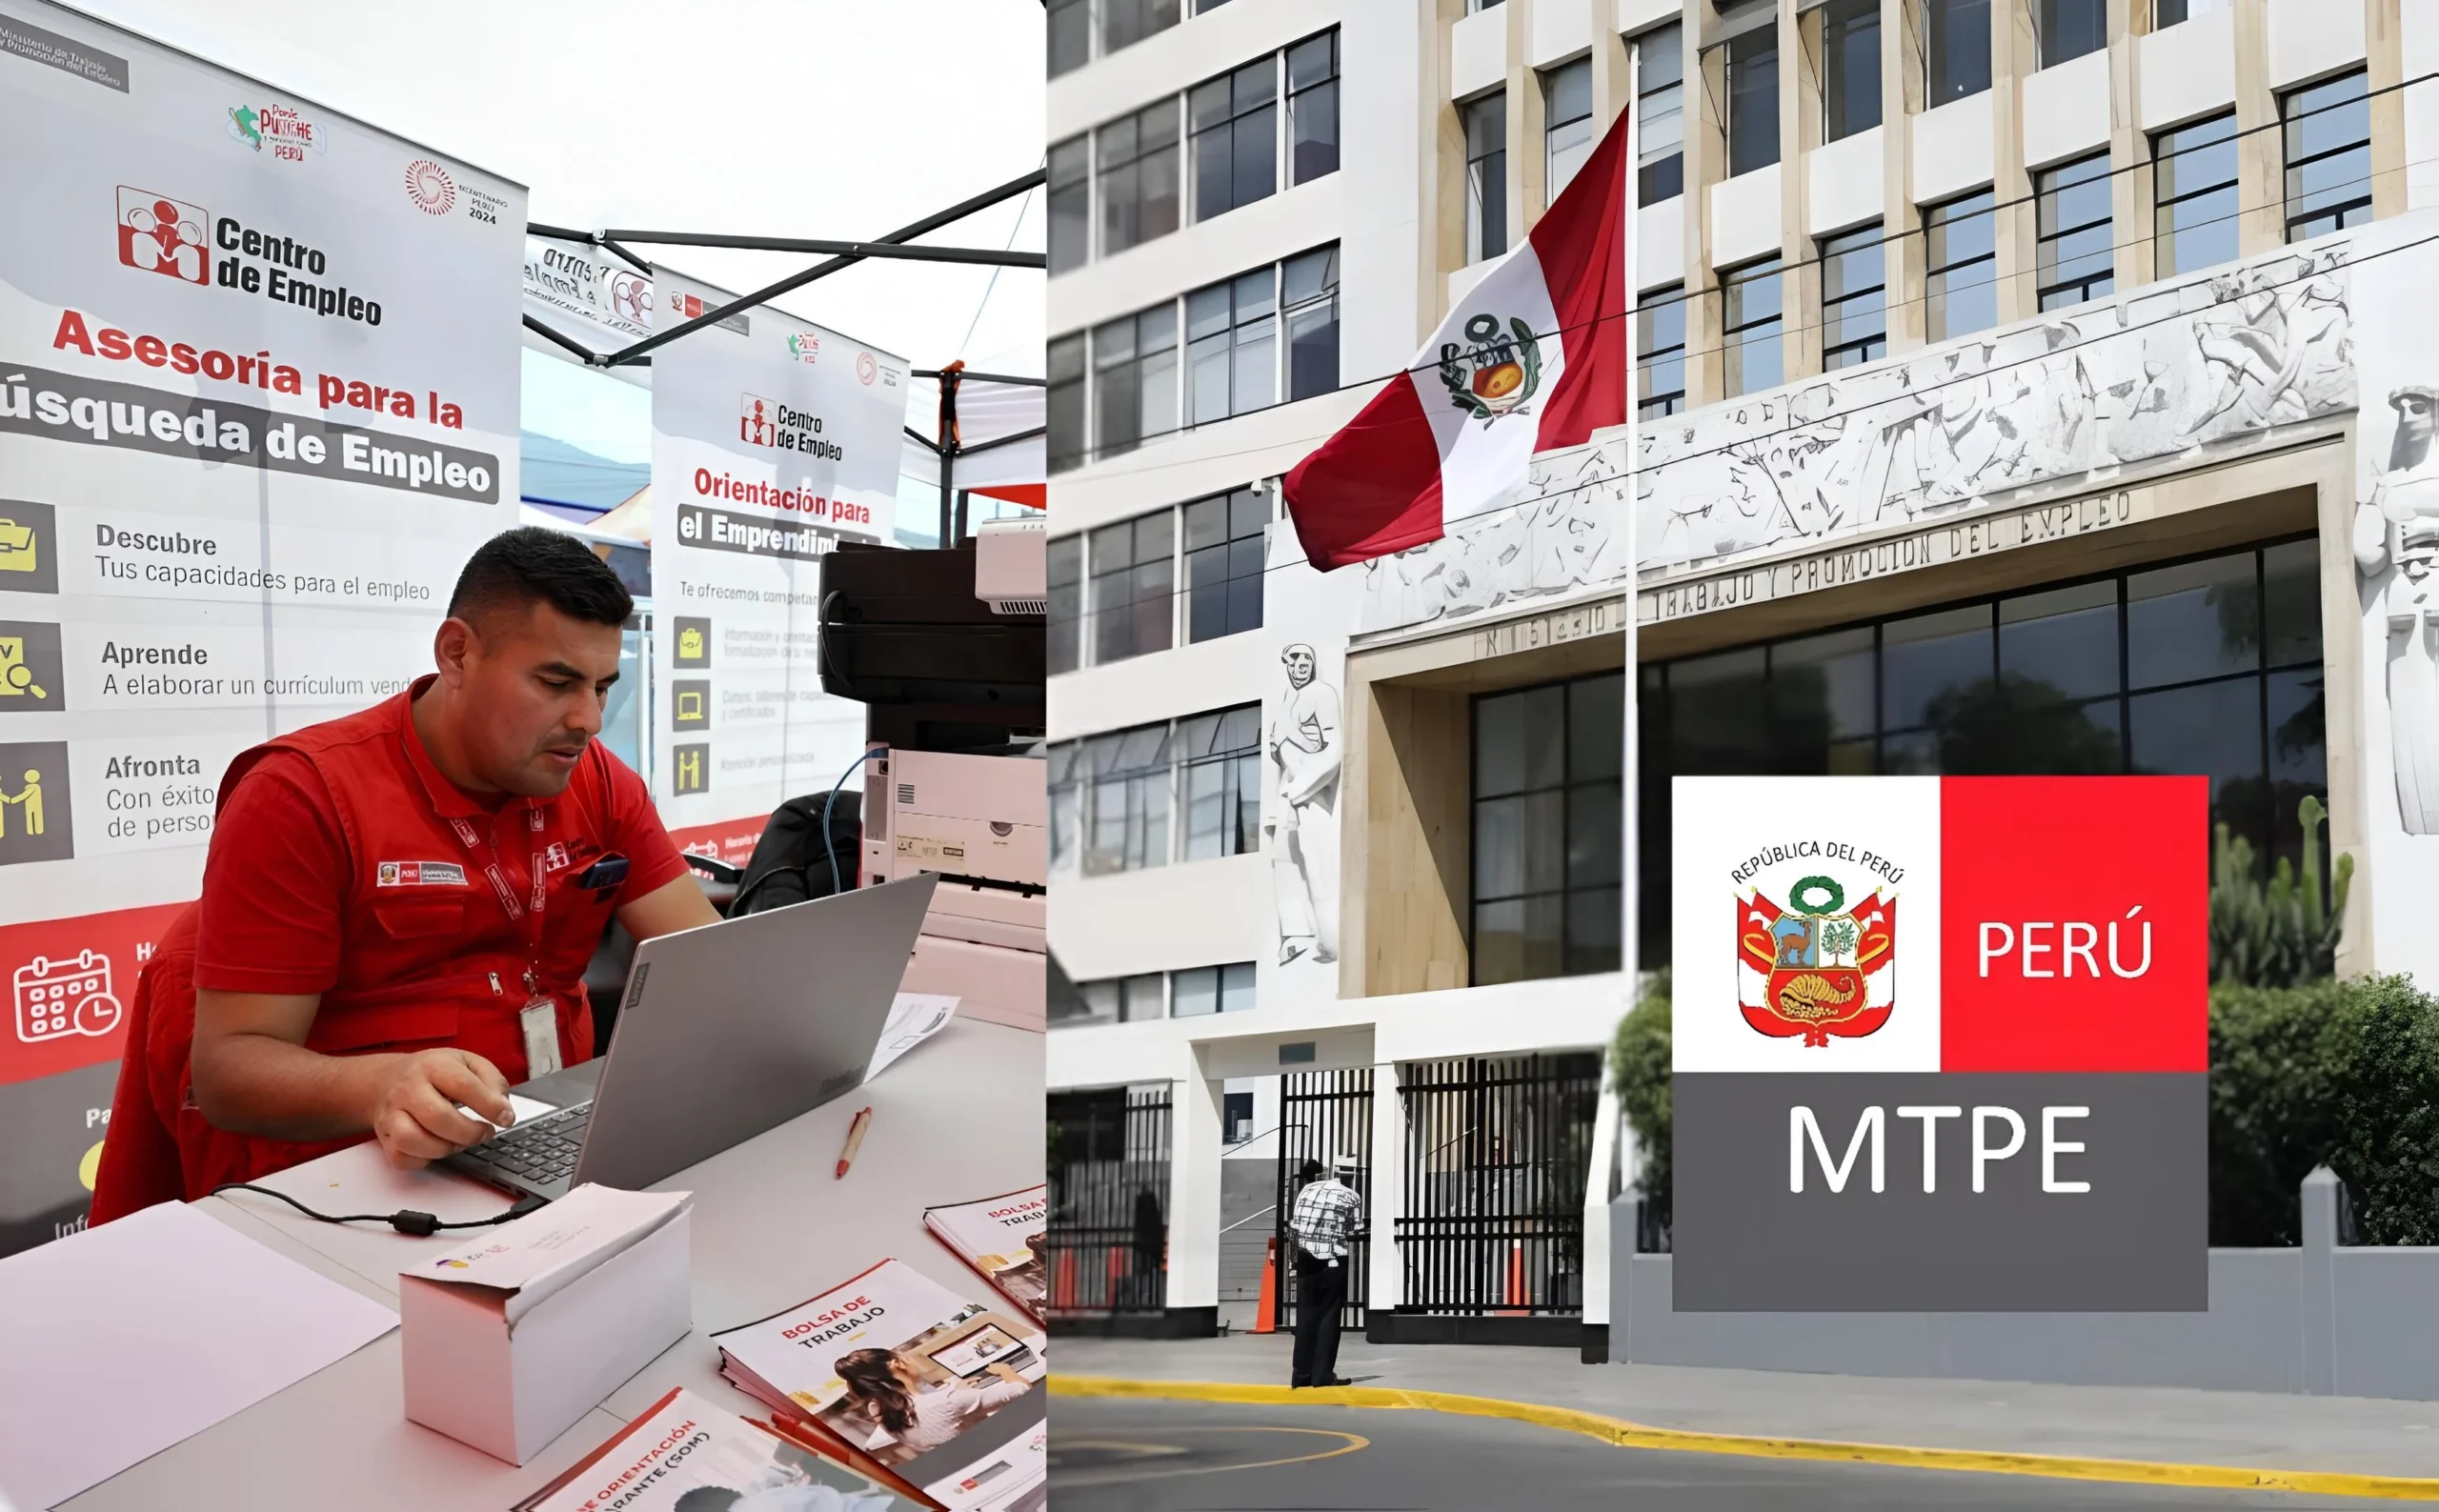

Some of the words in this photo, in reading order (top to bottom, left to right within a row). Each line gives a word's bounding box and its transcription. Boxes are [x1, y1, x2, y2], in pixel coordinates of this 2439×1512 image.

[469, 207, 497, 226] 2024
[215, 216, 326, 276] Centro
[217, 254, 260, 294] de
[268, 270, 383, 327] Empleo
[53, 309, 302, 395] Asesoría
[318, 373, 415, 420] para
[429, 391, 464, 430] la
[0, 373, 251, 454] úsqueda
[266, 423, 327, 464] de
[343, 433, 491, 494] Empleo
[777, 404, 822, 433] Centro
[776, 428, 795, 450] de
[797, 433, 843, 461] Empleo
[695, 467, 827, 515] Orientación
[832, 498, 871, 524] para
[96, 523, 217, 556] Descubre
[679, 512, 703, 539] el
[711, 514, 840, 555] Emprendimi
[1767, 568, 1778, 597] Y
[1950, 520, 1999, 558] DEL
[2021, 491, 2130, 544] EMPLEO
[95, 554, 138, 581] Tus
[145, 558, 287, 591] capacidades
[294, 576, 336, 595] para
[343, 577, 359, 595] el
[366, 579, 431, 602] empleo
[679, 581, 695, 597] Te
[697, 583, 760, 603] ofrecemos
[102, 641, 209, 669] Aprende
[103, 674, 119, 696] A
[126, 674, 225, 696] elaborar
[231, 677, 255, 696] un
[263, 674, 364, 696] currículum
[105, 755, 202, 780] Afronta
[108, 788, 152, 812] Con
[161, 783, 215, 808] éxito
[107, 816, 137, 838] de
[998, 1209, 1046, 1227] TRAB
[781, 1309, 847, 1340] BOLSA
[843, 1295, 872, 1312] DE
[797, 1306, 885, 1349] TRABAJO
[596, 1420, 697, 1501] ORIENTACIÓN
[664, 1431, 711, 1469] (SOM)
